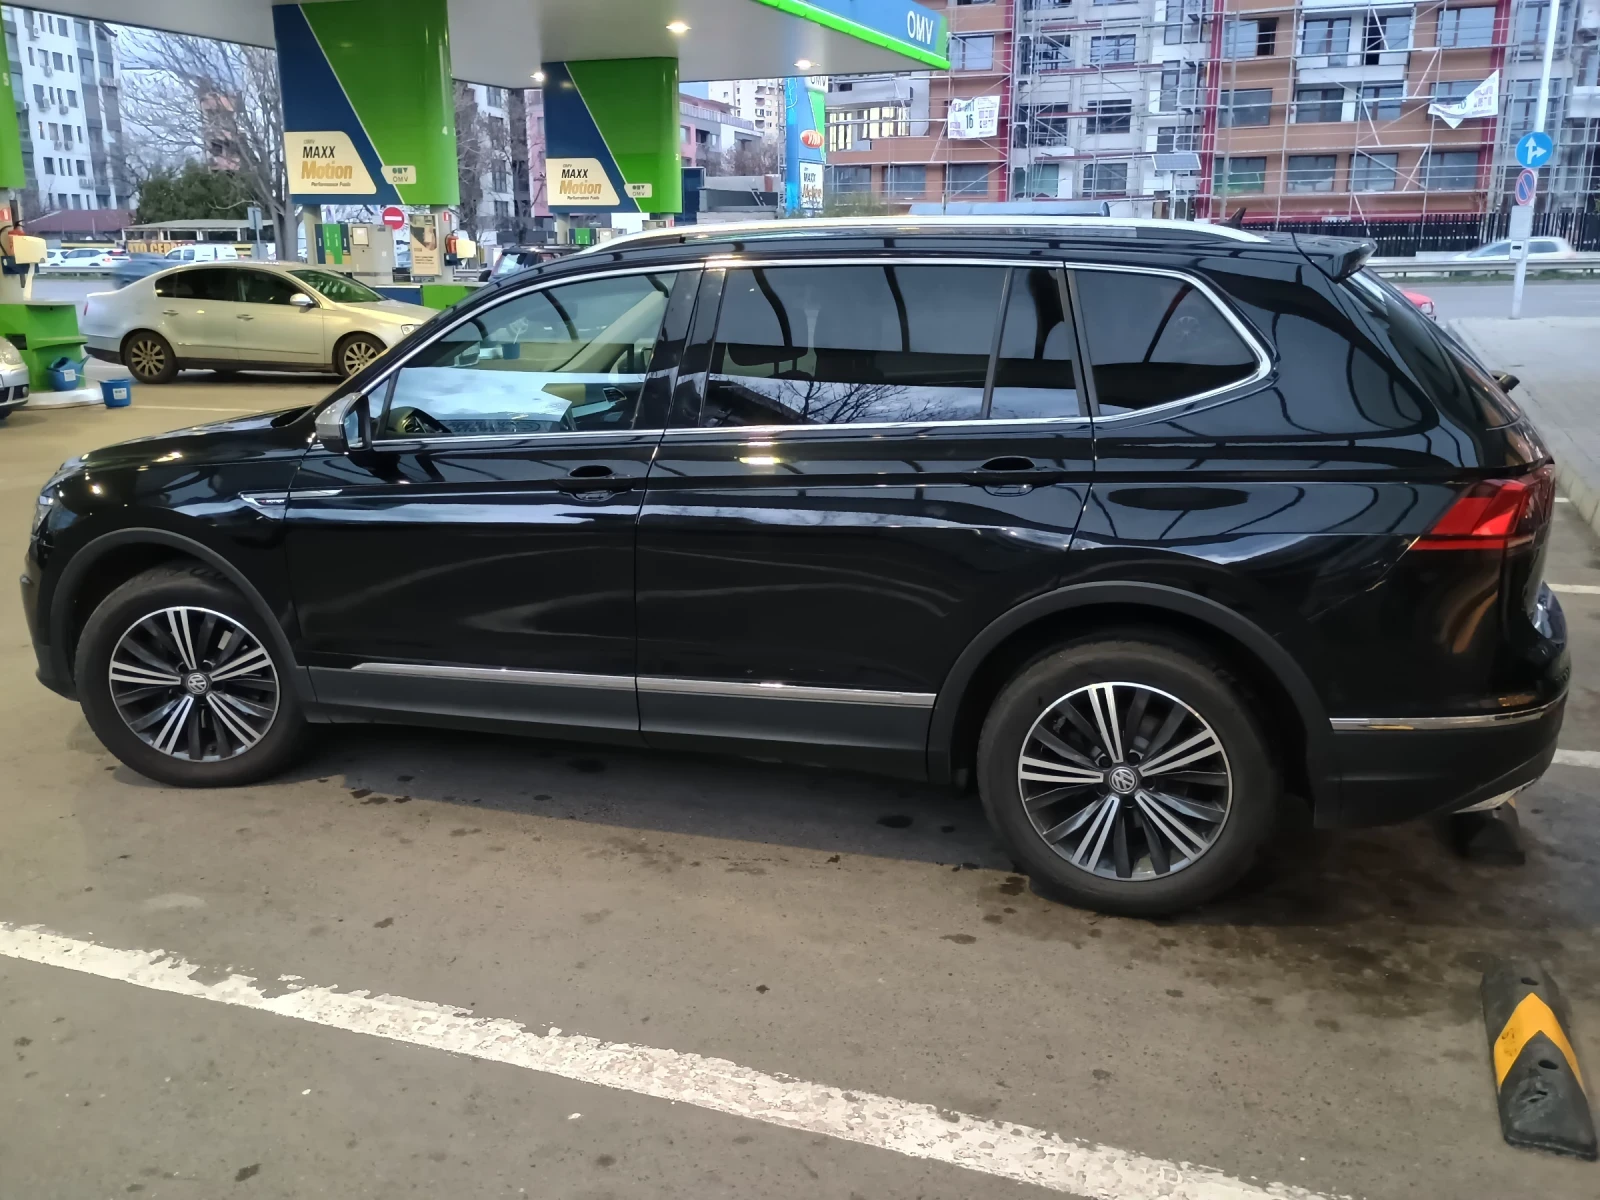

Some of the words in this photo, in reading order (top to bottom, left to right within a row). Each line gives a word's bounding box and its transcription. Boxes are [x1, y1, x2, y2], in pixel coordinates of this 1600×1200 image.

[907, 11, 934, 44] OMV
[966, 114, 973, 129] 16
[303, 146, 335, 158] MAXX
[302, 161, 352, 179] Motion
[562, 169, 588, 178] MAXX
[559, 180, 601, 194] Motion
